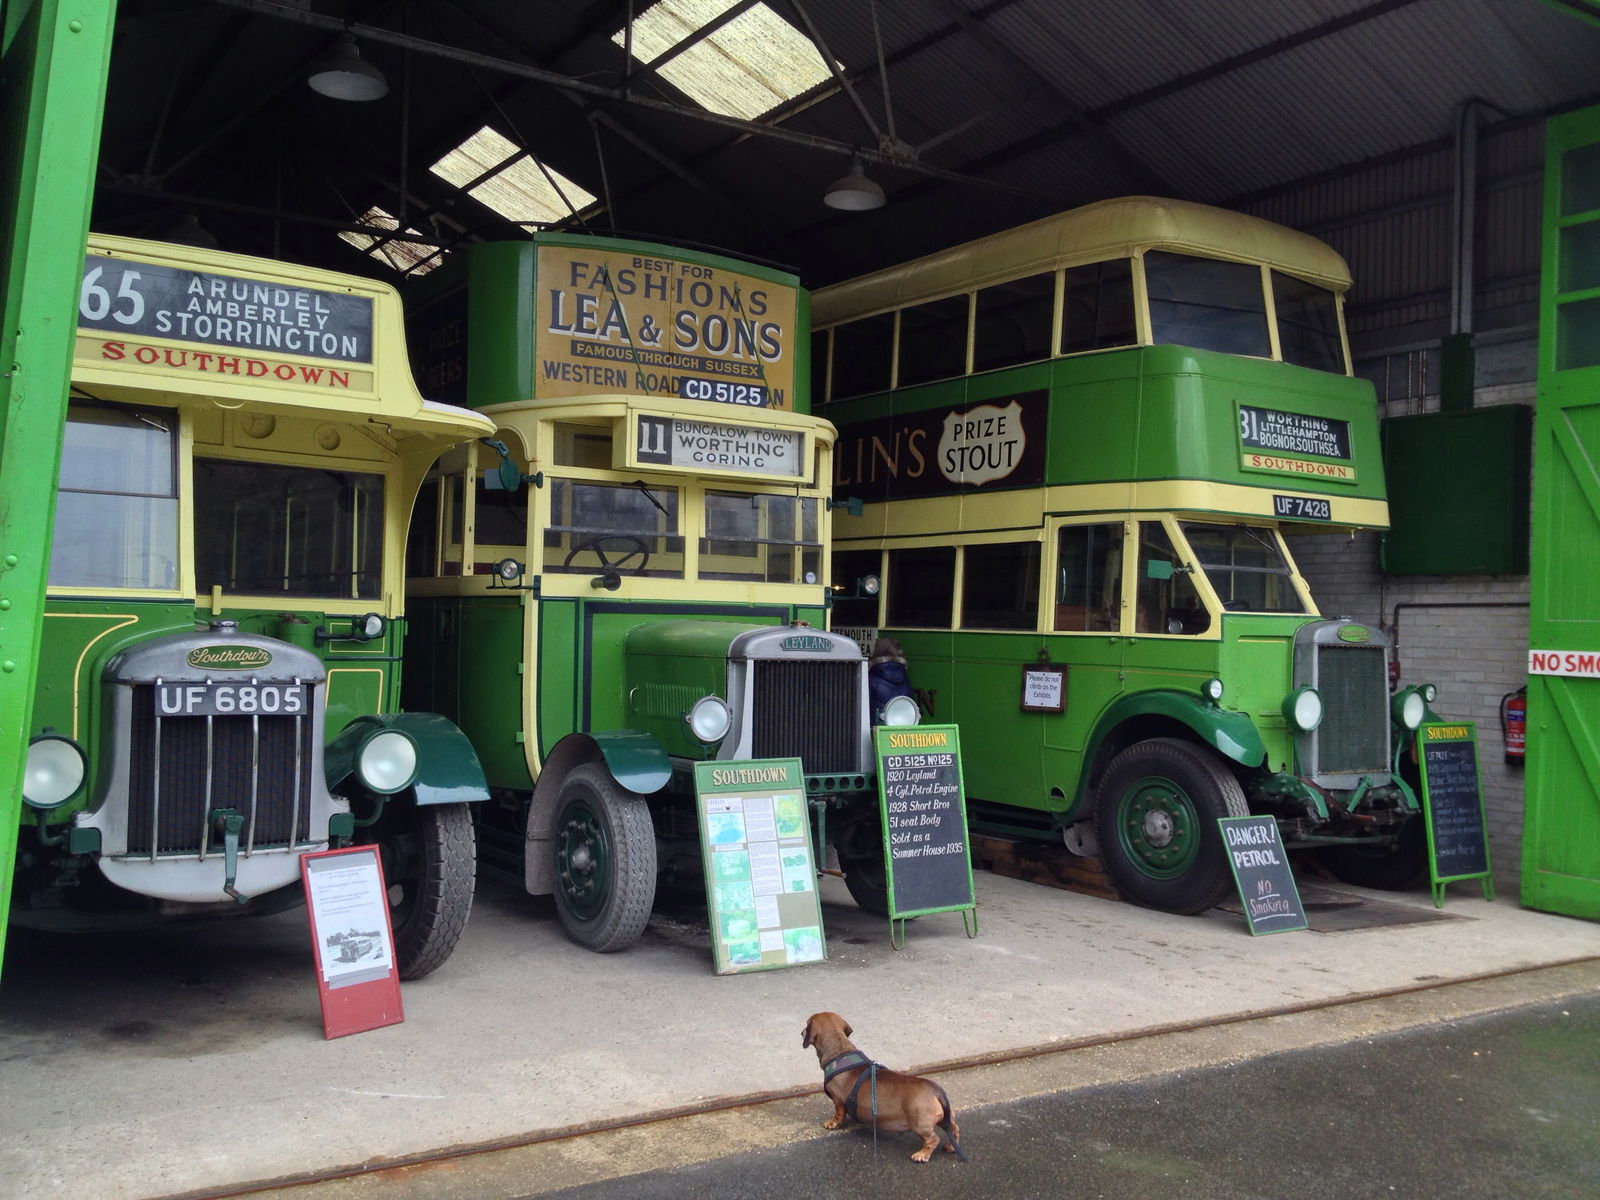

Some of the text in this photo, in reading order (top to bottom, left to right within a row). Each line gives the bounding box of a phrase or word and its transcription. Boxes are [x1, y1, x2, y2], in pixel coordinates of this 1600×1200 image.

[634, 258, 713, 280] BEST FOR
[80, 266, 145, 325] 65
[188, 276, 330, 314] ARUNDEL
[570, 261, 768, 316] FASHIONS
[187, 297, 329, 331] AMBERLEY
[155, 310, 358, 358] STORRINGTON
[548, 289, 782, 362] LEA & SONS
[102, 341, 350, 388] SOUTHDOWN
[576, 343, 759, 377] FAMOUS THROUGH SUSSEX
[542, 360, 628, 388] WESTERN
[686, 379, 713, 400] CD
[715, 383, 761, 406] 5125
[953, 416, 1006, 441] PRIZE
[1240, 409, 1259, 441] 31
[1266, 411, 1328, 431] WORTHING
[640, 422, 667, 454] 11
[675, 422, 792, 444] BUNGALOW TOWN
[1260, 423, 1337, 443] LITTLEHAMPTON
[679, 434, 784, 457] WORTHING
[693, 450, 765, 468] GORING
[945, 440, 1018, 474] STOUT
[1252, 455, 1347, 477] SOUTHDOWN
[1276, 498, 1329, 517] UF 7428
[785, 636, 830, 650] LEYLAND
[191, 649, 269, 665] Southdown
[1532, 653, 1600, 673] NO SM
[161, 687, 301, 713] UF 6805
[889, 733, 947, 748] SOUTHDOWN
[1427, 727, 1468, 739] SOUTHDOWN
[888, 757, 902, 767] CD
[904, 756, 926, 766] 5125
[712, 767, 788, 786] SOUTHDOWN
[886, 769, 937, 783] 1920 Leyland
[887, 788, 893, 798] 4
[934, 783, 959, 796] Engine
[889, 799, 951, 813] 1928 Short Bros
[889, 814, 941, 829] 51 seat Body
[891, 832, 931, 845] Sold as a
[1226, 823, 1276, 846] DANGER!
[892, 842, 963, 860] Summer House 1935
[1233, 849, 1280, 869] PETROL
[1258, 880, 1272, 895] NO
[1250, 899, 1290, 917] Smoking
